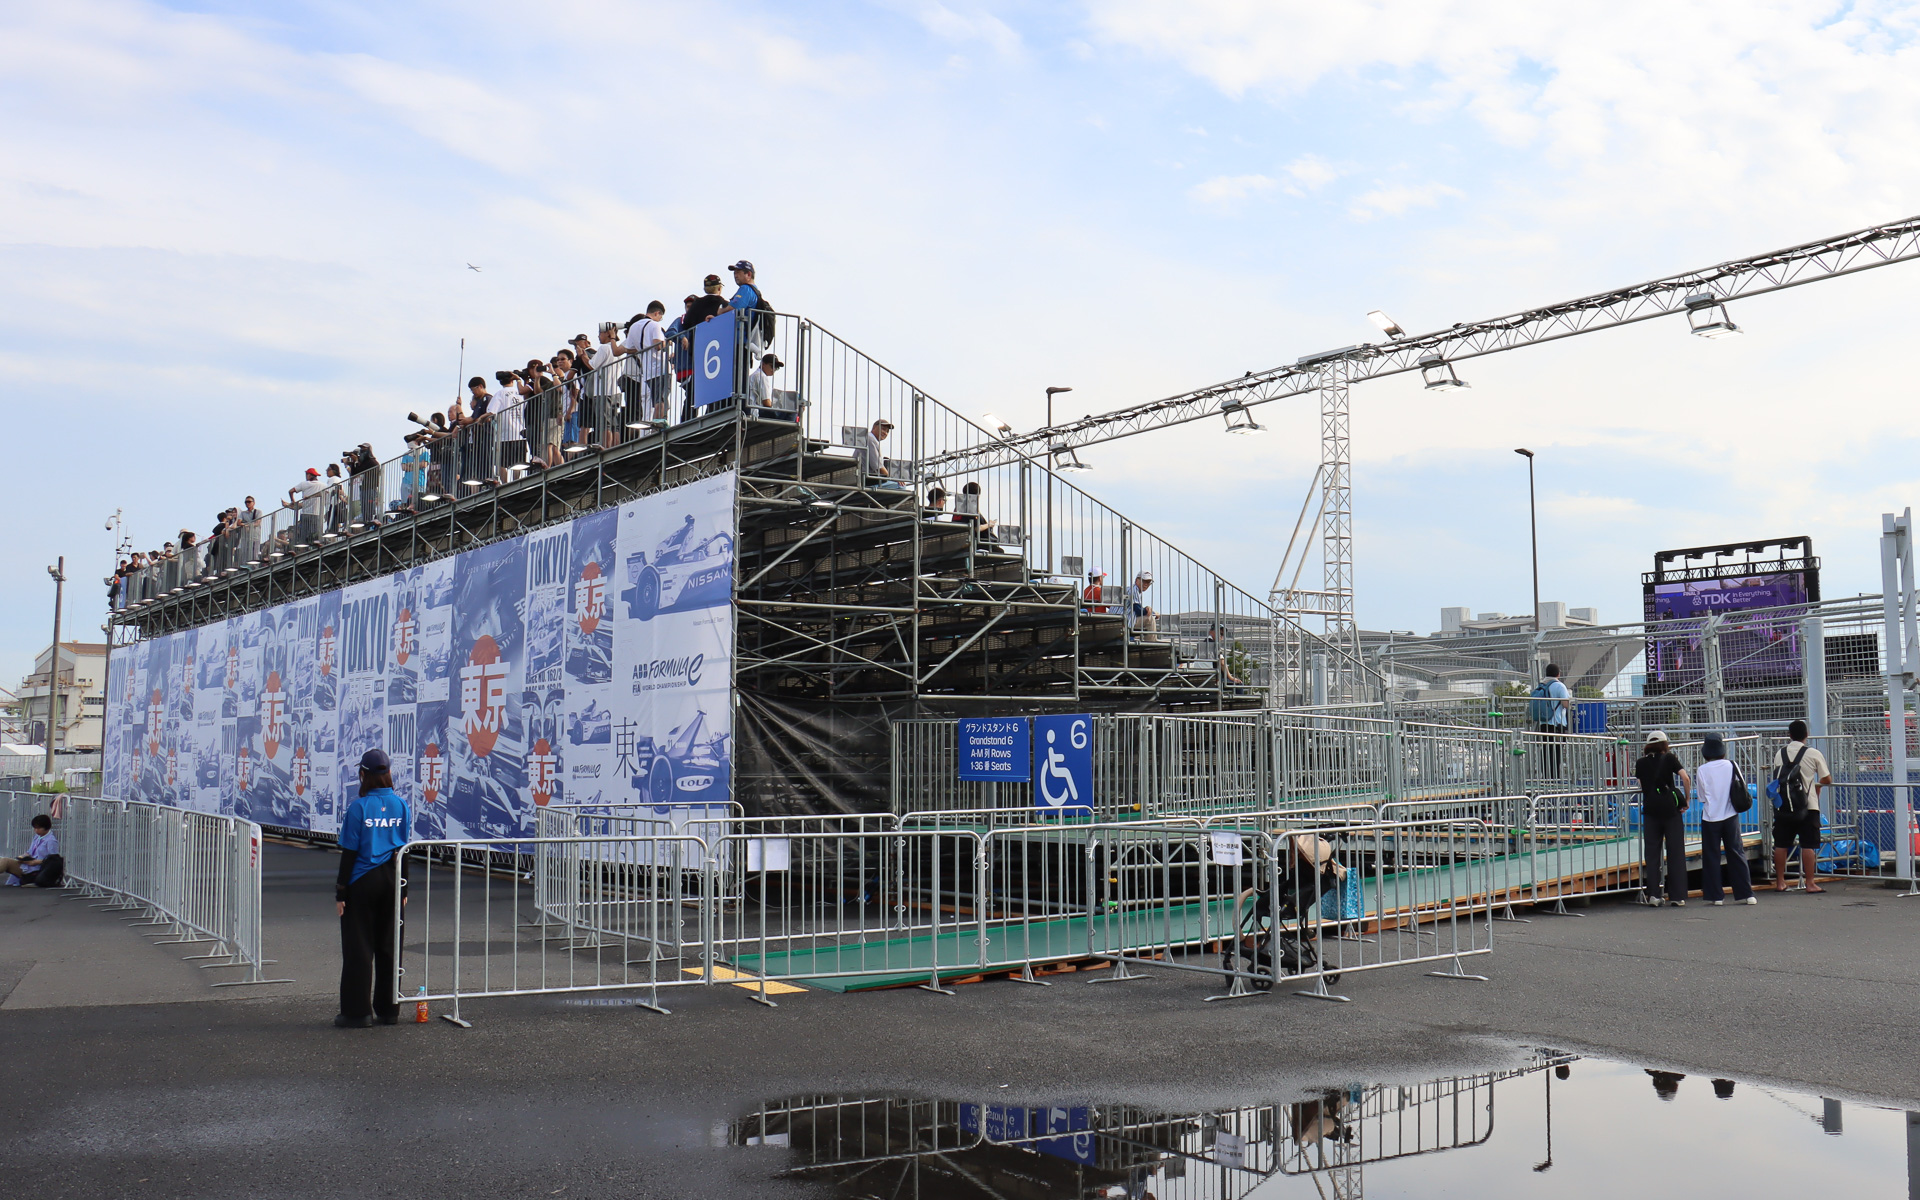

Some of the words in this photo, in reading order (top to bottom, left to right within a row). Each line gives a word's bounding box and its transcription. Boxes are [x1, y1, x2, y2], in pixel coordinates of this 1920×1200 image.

[704, 340, 720, 380] 6
[530, 532, 569, 591] TOKYO
[655, 550, 663, 559] 23
[688, 567, 729, 589] NISSAN
[575, 574, 607, 621] 東京
[1701, 593, 1731, 605] TDK
[341, 591, 389, 679] TOKYO
[395, 618, 415, 656] 東京
[633, 664, 648, 680] ABB
[648, 656, 690, 680] FORMULA
[460, 656, 511, 736] 東京
[657, 681, 687, 690] CHAMPIONSHIP
[261, 687, 287, 743] 東京
[966, 723, 1011, 733] グランドスタンド
[1012, 723, 1019, 733] 6
[388, 712, 415, 757] TOKYO
[969, 736, 1006, 745] Grandstand
[1007, 736, 1013, 745] 6
[1070, 720, 1087, 749] 6
[971, 749, 984, 758] A-M
[984, 748, 990, 758] 列
[991, 749, 1011, 758] Rows
[420, 754, 444, 792] 東京
[527, 752, 558, 795] 東京
[970, 762, 983, 771] 1-36
[991, 762, 1011, 771] Seats
[680, 777, 711, 787] LOLA
[365, 817, 402, 828] STAFF
